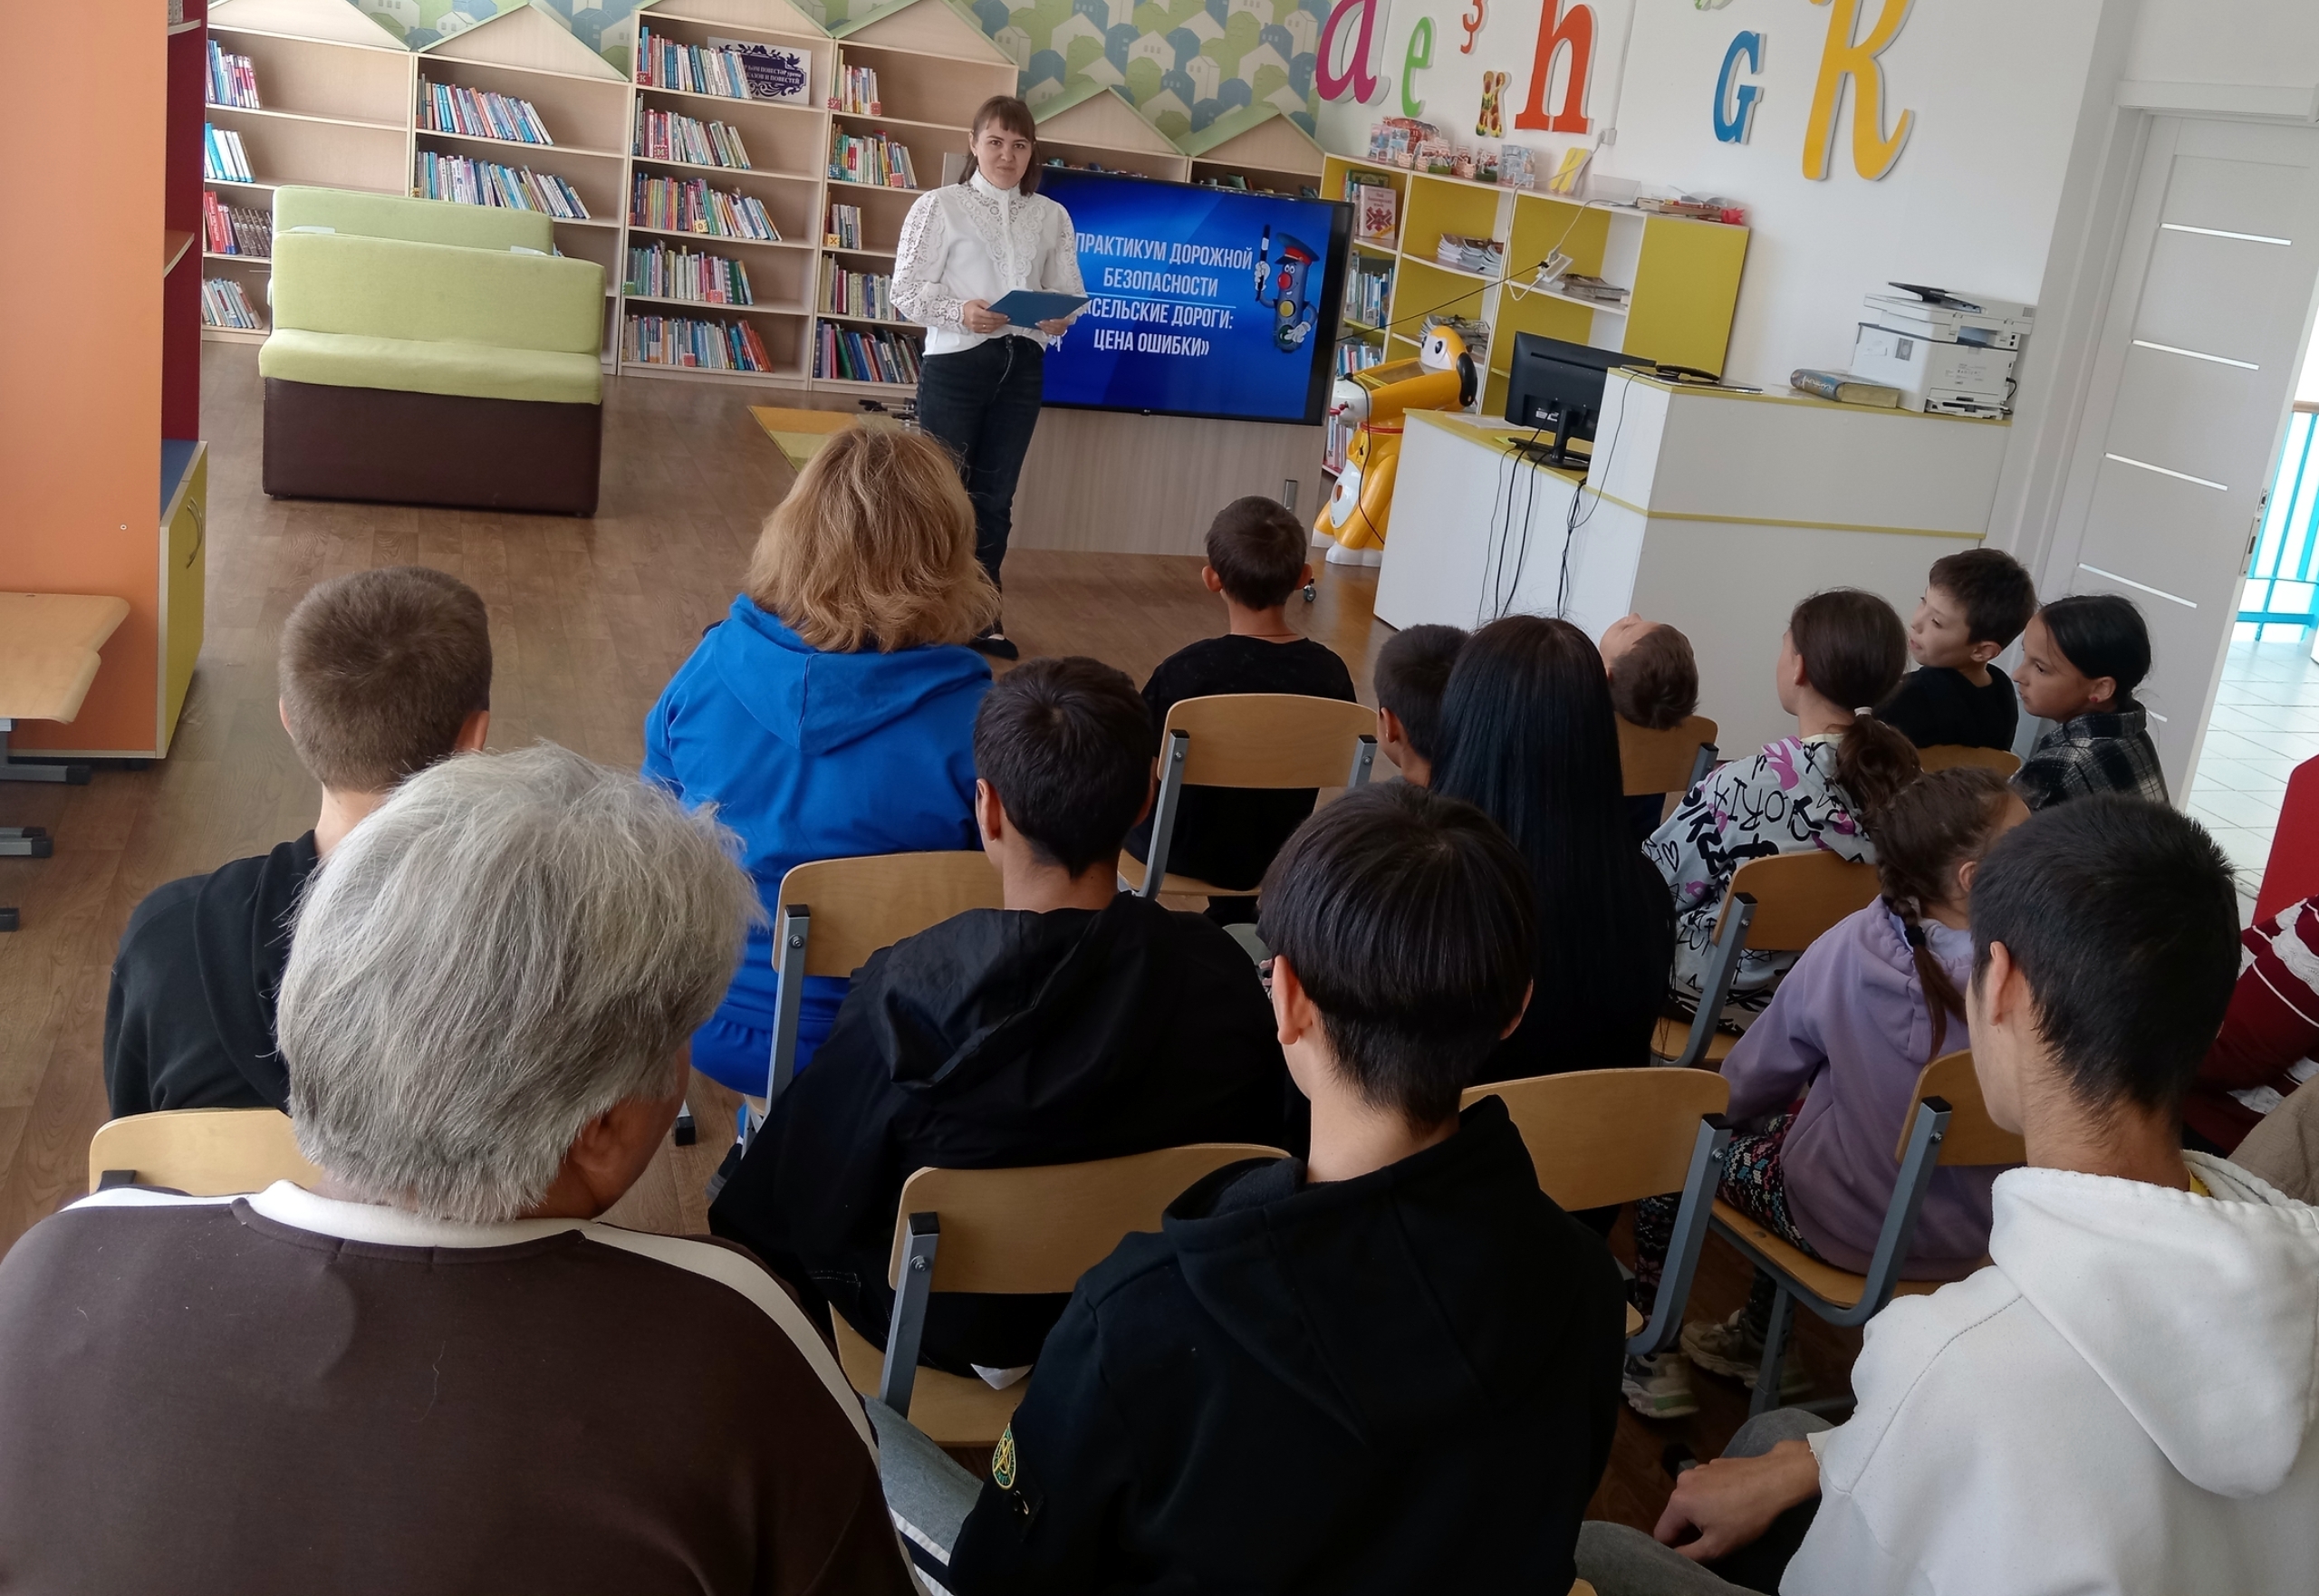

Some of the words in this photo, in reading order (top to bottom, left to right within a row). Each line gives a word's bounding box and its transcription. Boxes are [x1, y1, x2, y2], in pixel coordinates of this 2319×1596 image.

[1401, 16, 1434, 118] e
[1713, 30, 1762, 143] G
[1075, 232, 1168, 262] ПРАКТИКУМ
[1169, 243, 1254, 271] ДОРОЖНОЙ
[1102, 267, 1219, 297] БЕЗОПАСНОСТИ
[1170, 304, 1235, 330] ДОРОГИ:
[1092, 328, 1134, 351] ЦЕНА
[1137, 332, 1210, 357] ОШИБКИ»
